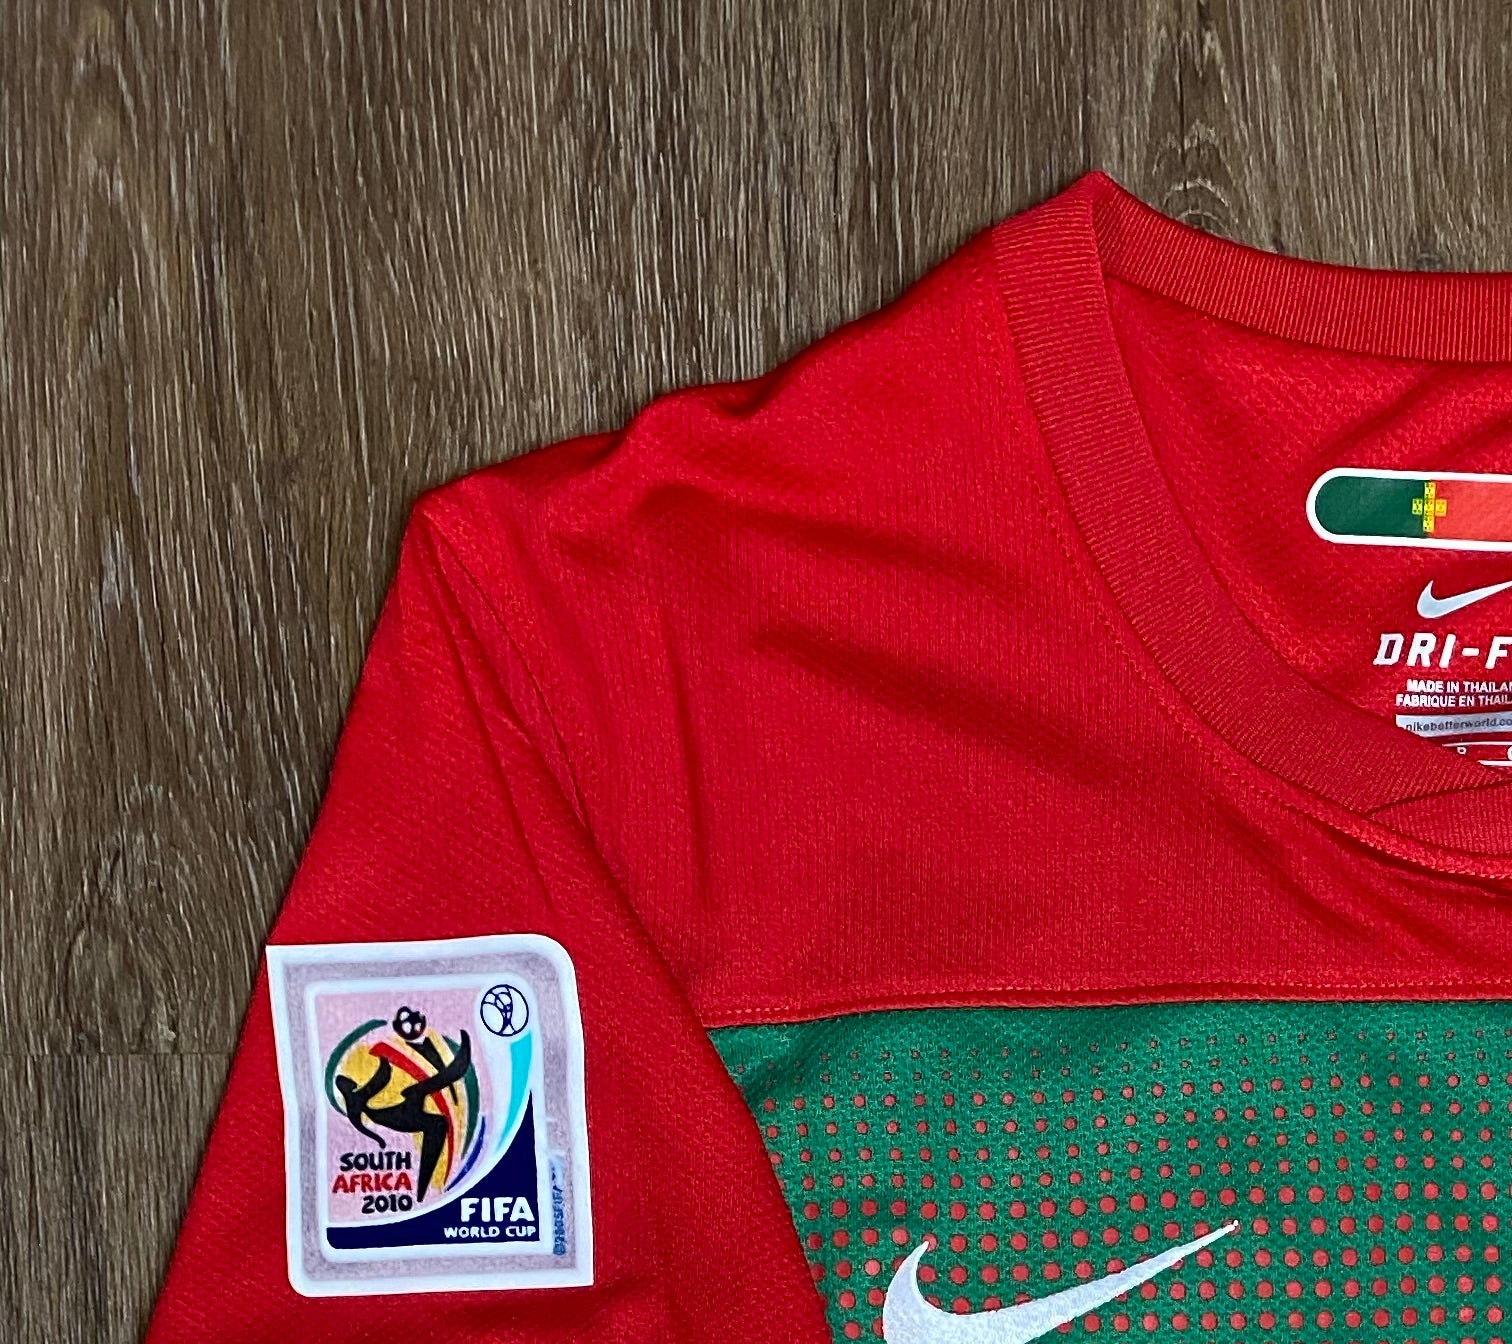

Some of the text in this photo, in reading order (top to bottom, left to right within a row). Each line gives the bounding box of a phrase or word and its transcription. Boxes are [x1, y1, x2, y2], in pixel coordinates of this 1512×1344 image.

[1406, 678, 1444, 693] MADE
[1446, 681, 1460, 693] IN
[1395, 693, 1456, 707] FABRIQUE
[1458, 696, 1475, 707] EN
[340, 1151, 412, 1172] SOUTH
[332, 1172, 413, 1193] AFRICA
[361, 1194, 413, 1214] 2010
[460, 1197, 535, 1222] FIFA
[443, 1225, 537, 1238] WORLD CUP
